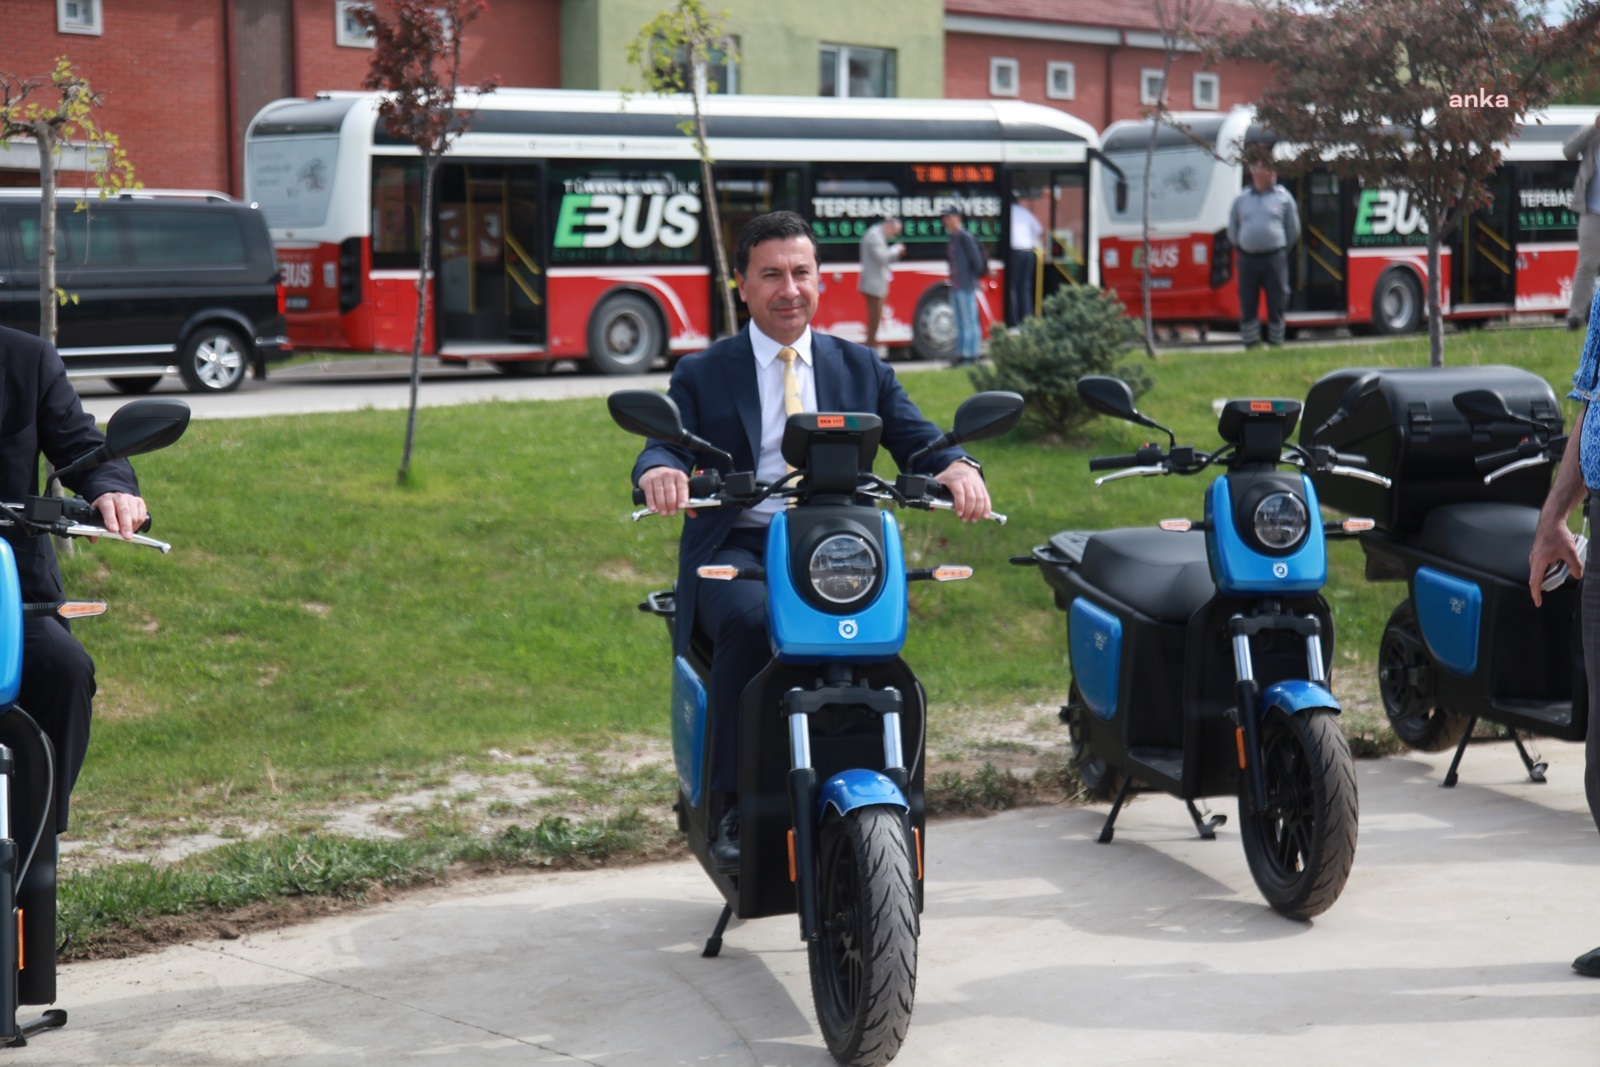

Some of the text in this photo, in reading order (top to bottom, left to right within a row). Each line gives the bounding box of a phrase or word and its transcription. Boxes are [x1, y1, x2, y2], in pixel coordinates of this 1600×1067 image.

[553, 193, 702, 248] EBUS
[1354, 189, 1430, 235] EBU
[1518, 189, 1575, 209] TEPEBAŞ
